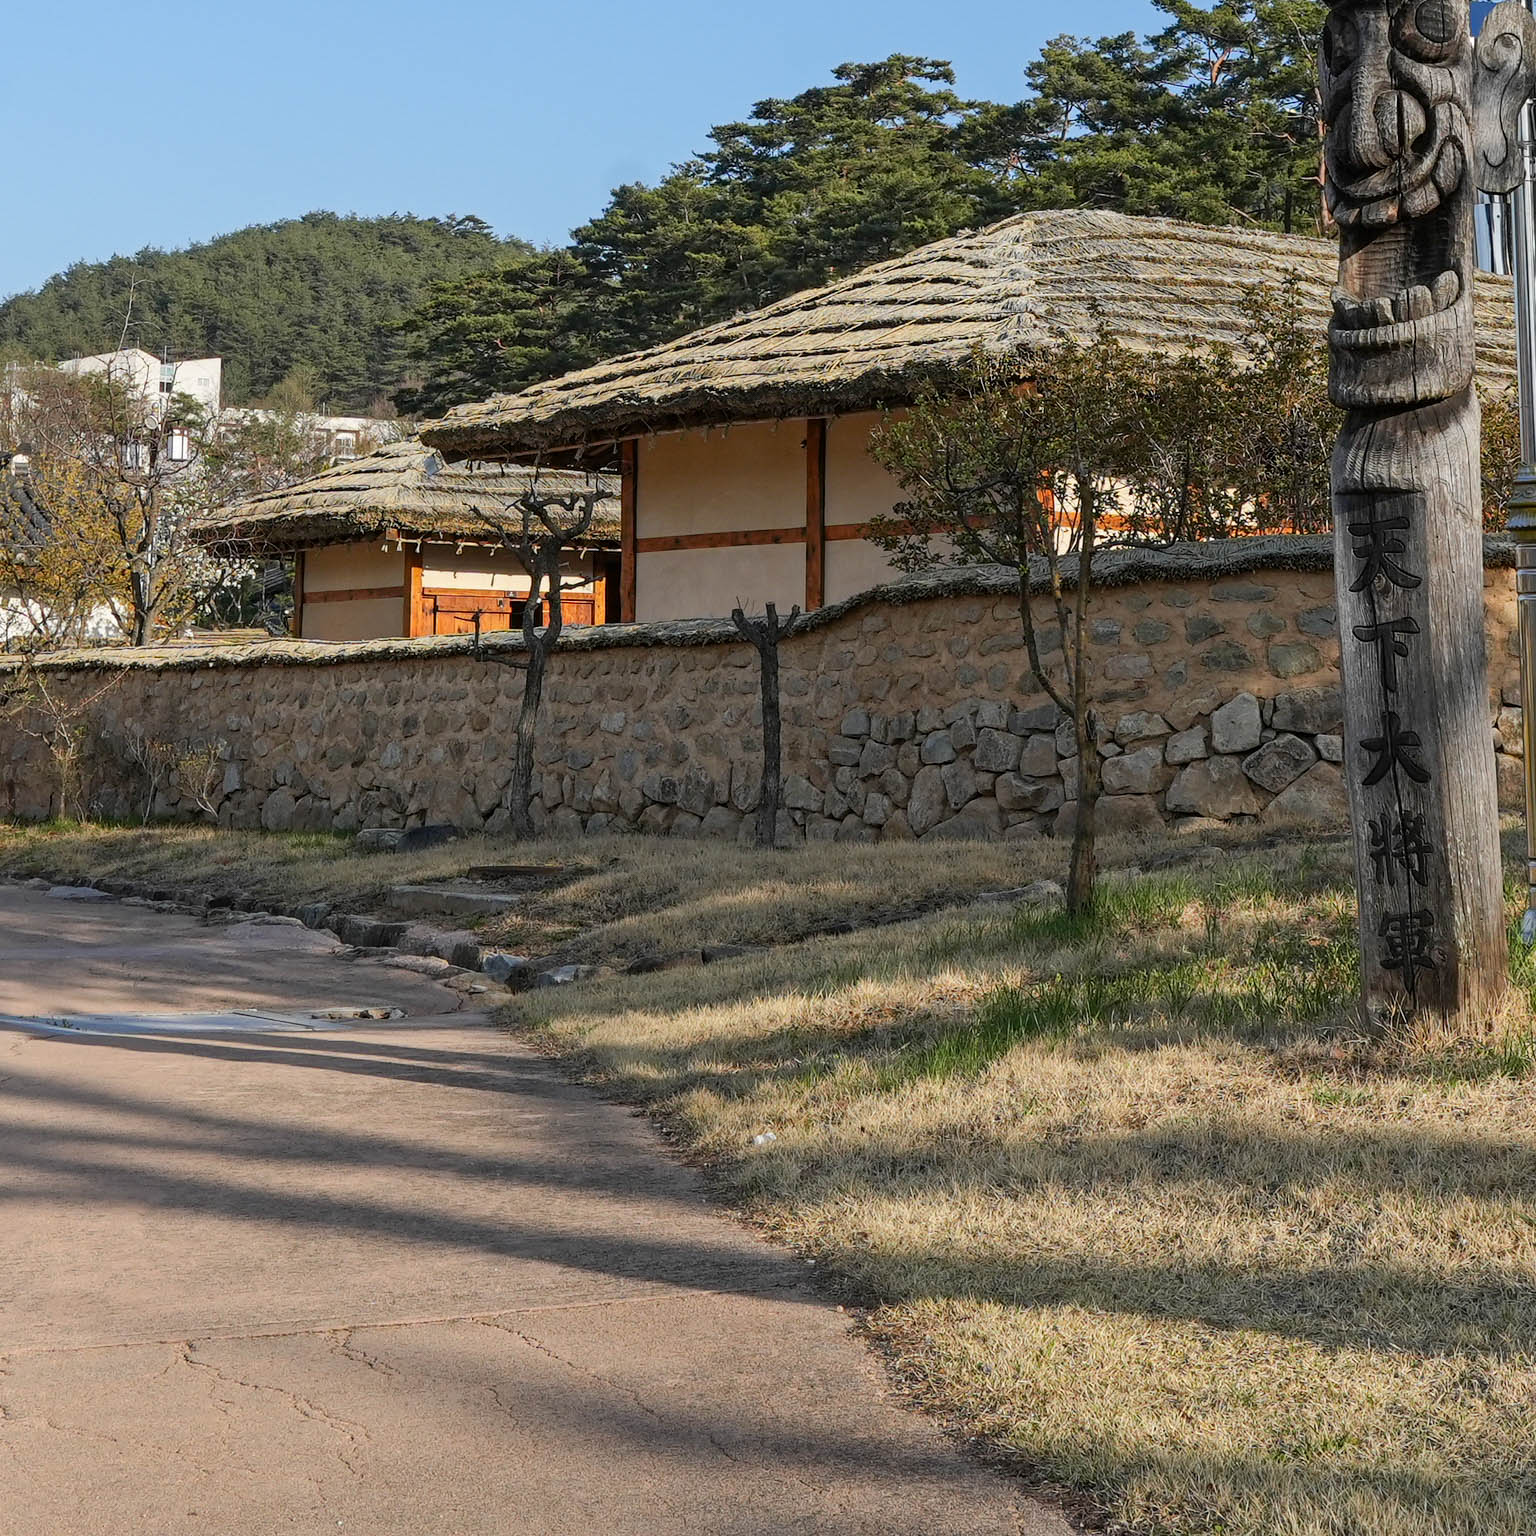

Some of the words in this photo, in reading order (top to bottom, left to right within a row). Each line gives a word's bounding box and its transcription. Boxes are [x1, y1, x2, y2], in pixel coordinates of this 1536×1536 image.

[1348, 515, 1435, 991] 天下大將軍
